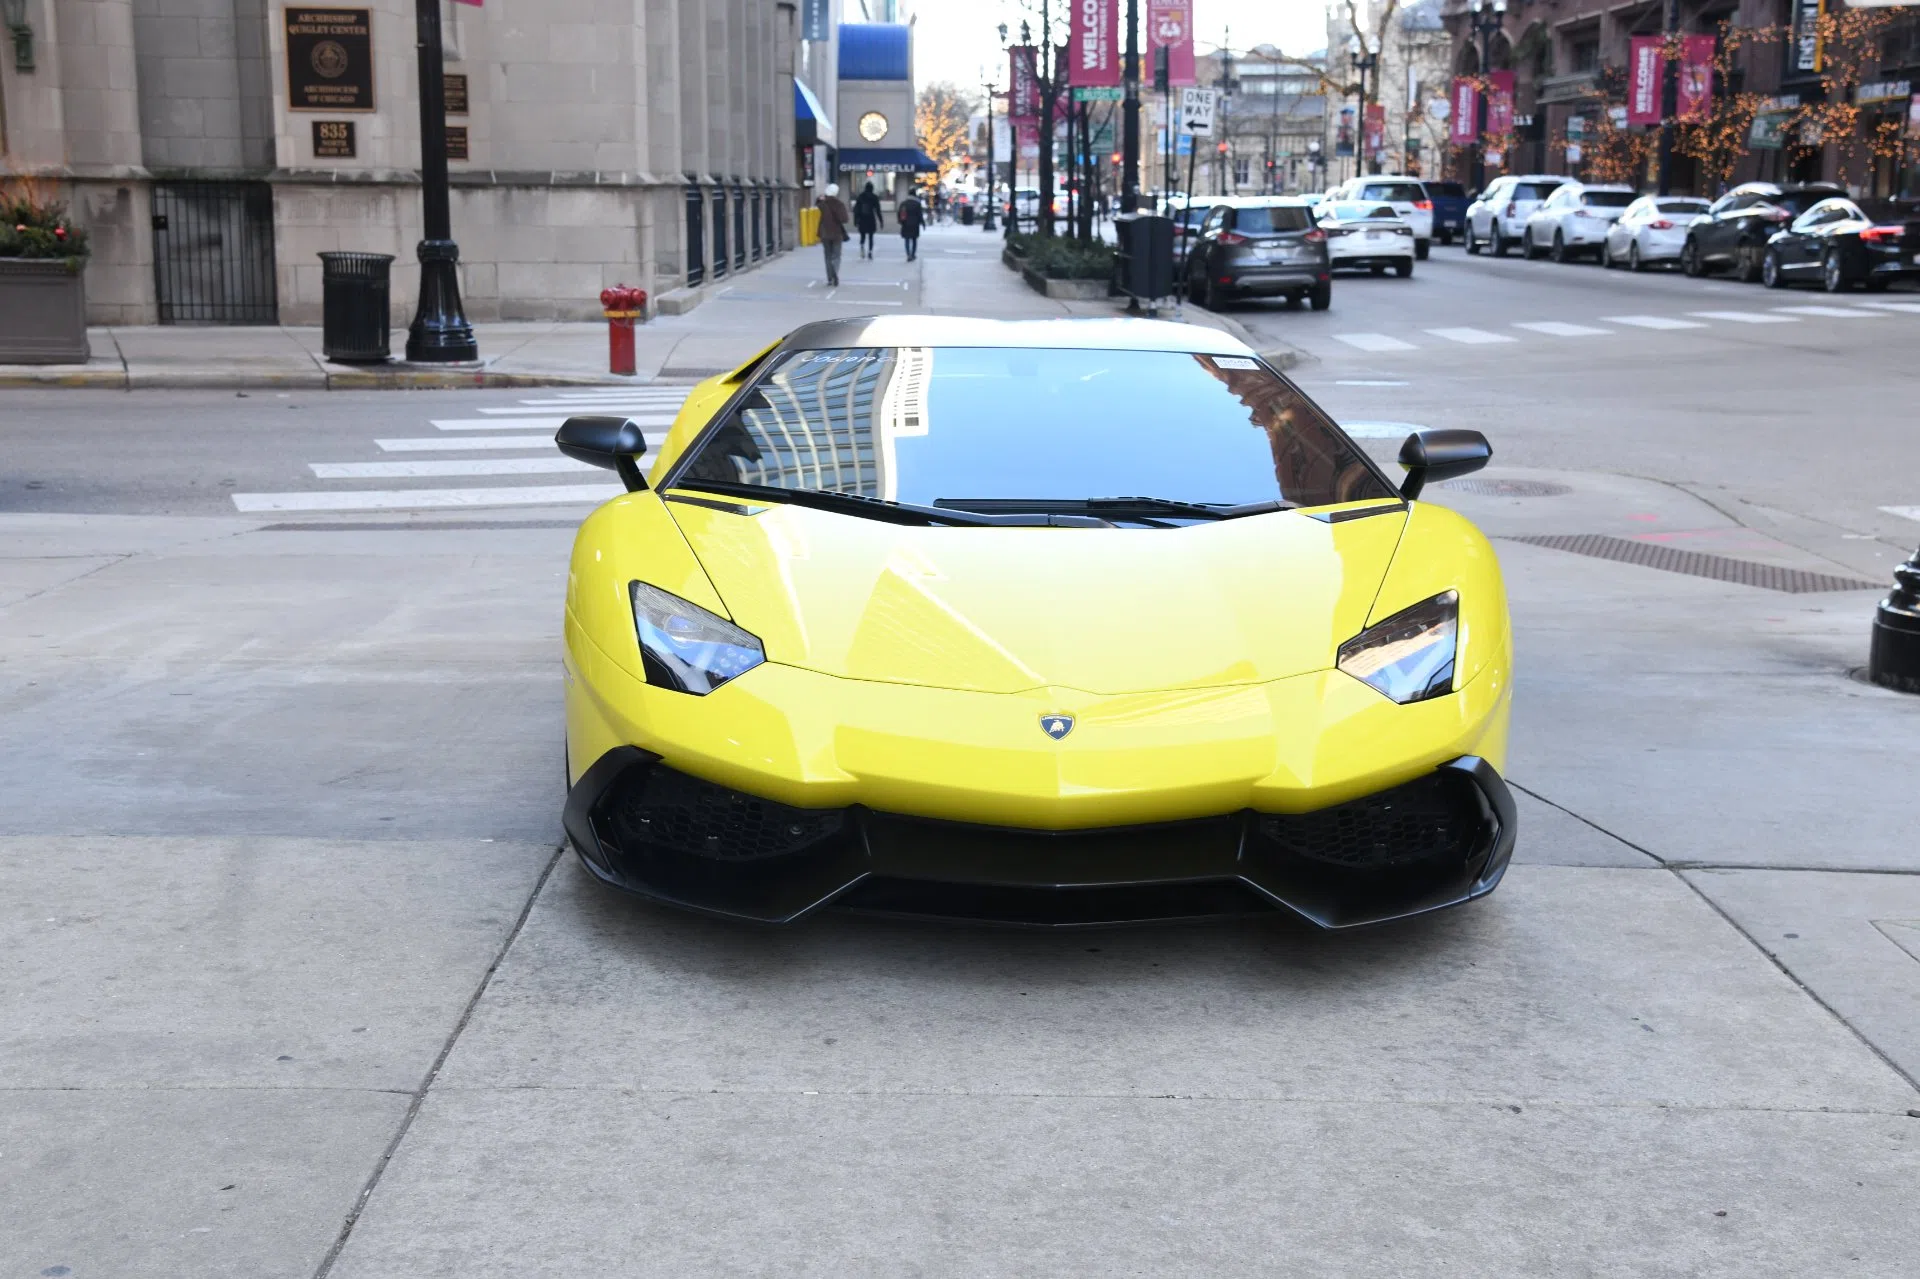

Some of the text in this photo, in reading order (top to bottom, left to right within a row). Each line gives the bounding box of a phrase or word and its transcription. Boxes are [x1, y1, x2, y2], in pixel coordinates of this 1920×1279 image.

[297, 13, 358, 24] ARCHBISHOP
[1099, 8, 1108, 39] TOWER
[287, 24, 367, 35] QUIGLEY CENTER
[1099, 41, 1108, 71] WATER
[1635, 47, 1649, 113] WELCOME
[1186, 91, 1212, 104] ONE
[1185, 105, 1211, 117] WAY
[320, 124, 348, 138] 835
[839, 163, 916, 173] GHIRARDELLI
